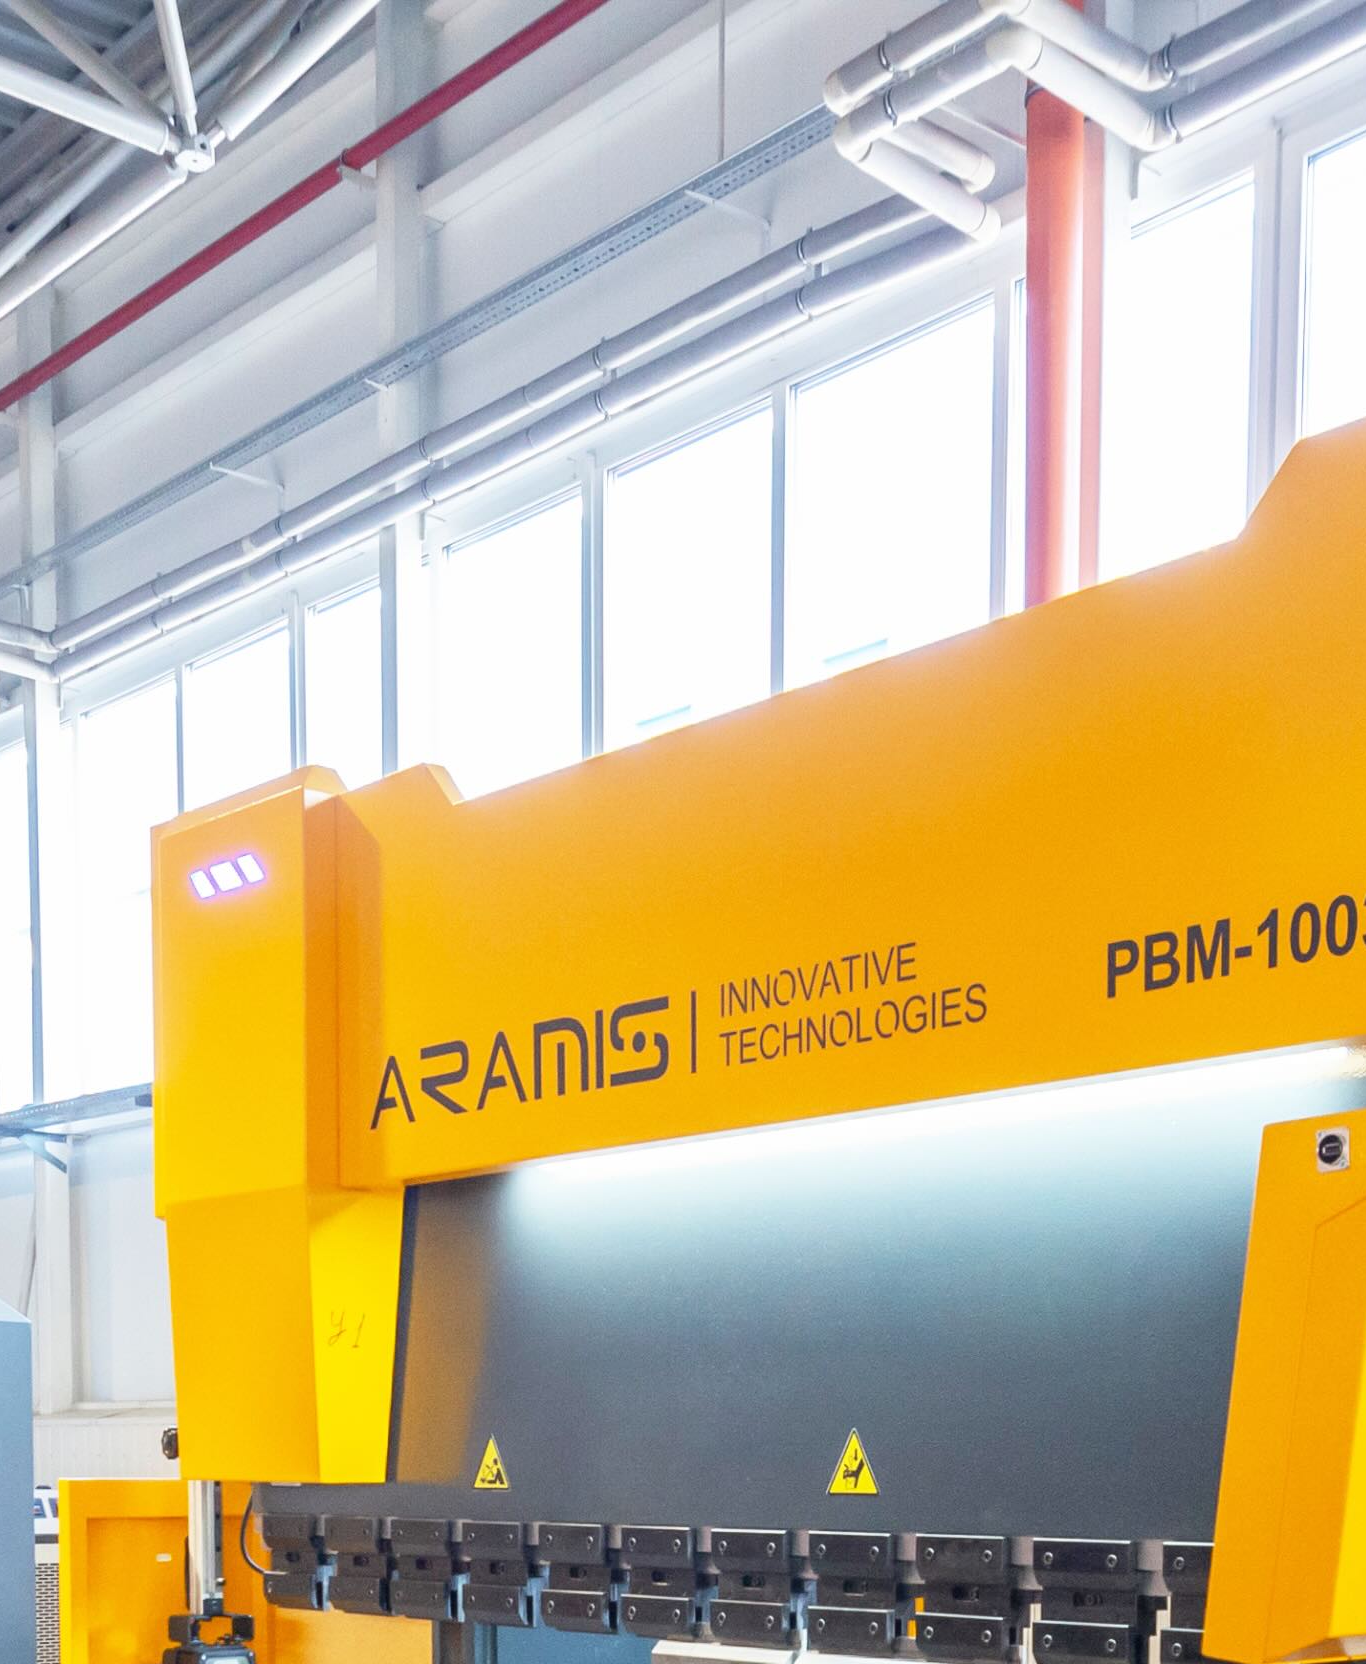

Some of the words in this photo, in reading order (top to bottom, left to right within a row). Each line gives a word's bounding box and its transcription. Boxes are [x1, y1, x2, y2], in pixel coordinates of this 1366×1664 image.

[719, 941, 918, 1018] INNOVATIVE
[369, 995, 669, 1131] ARAMIS
[719, 983, 989, 1067] TECHNOLOGIES
